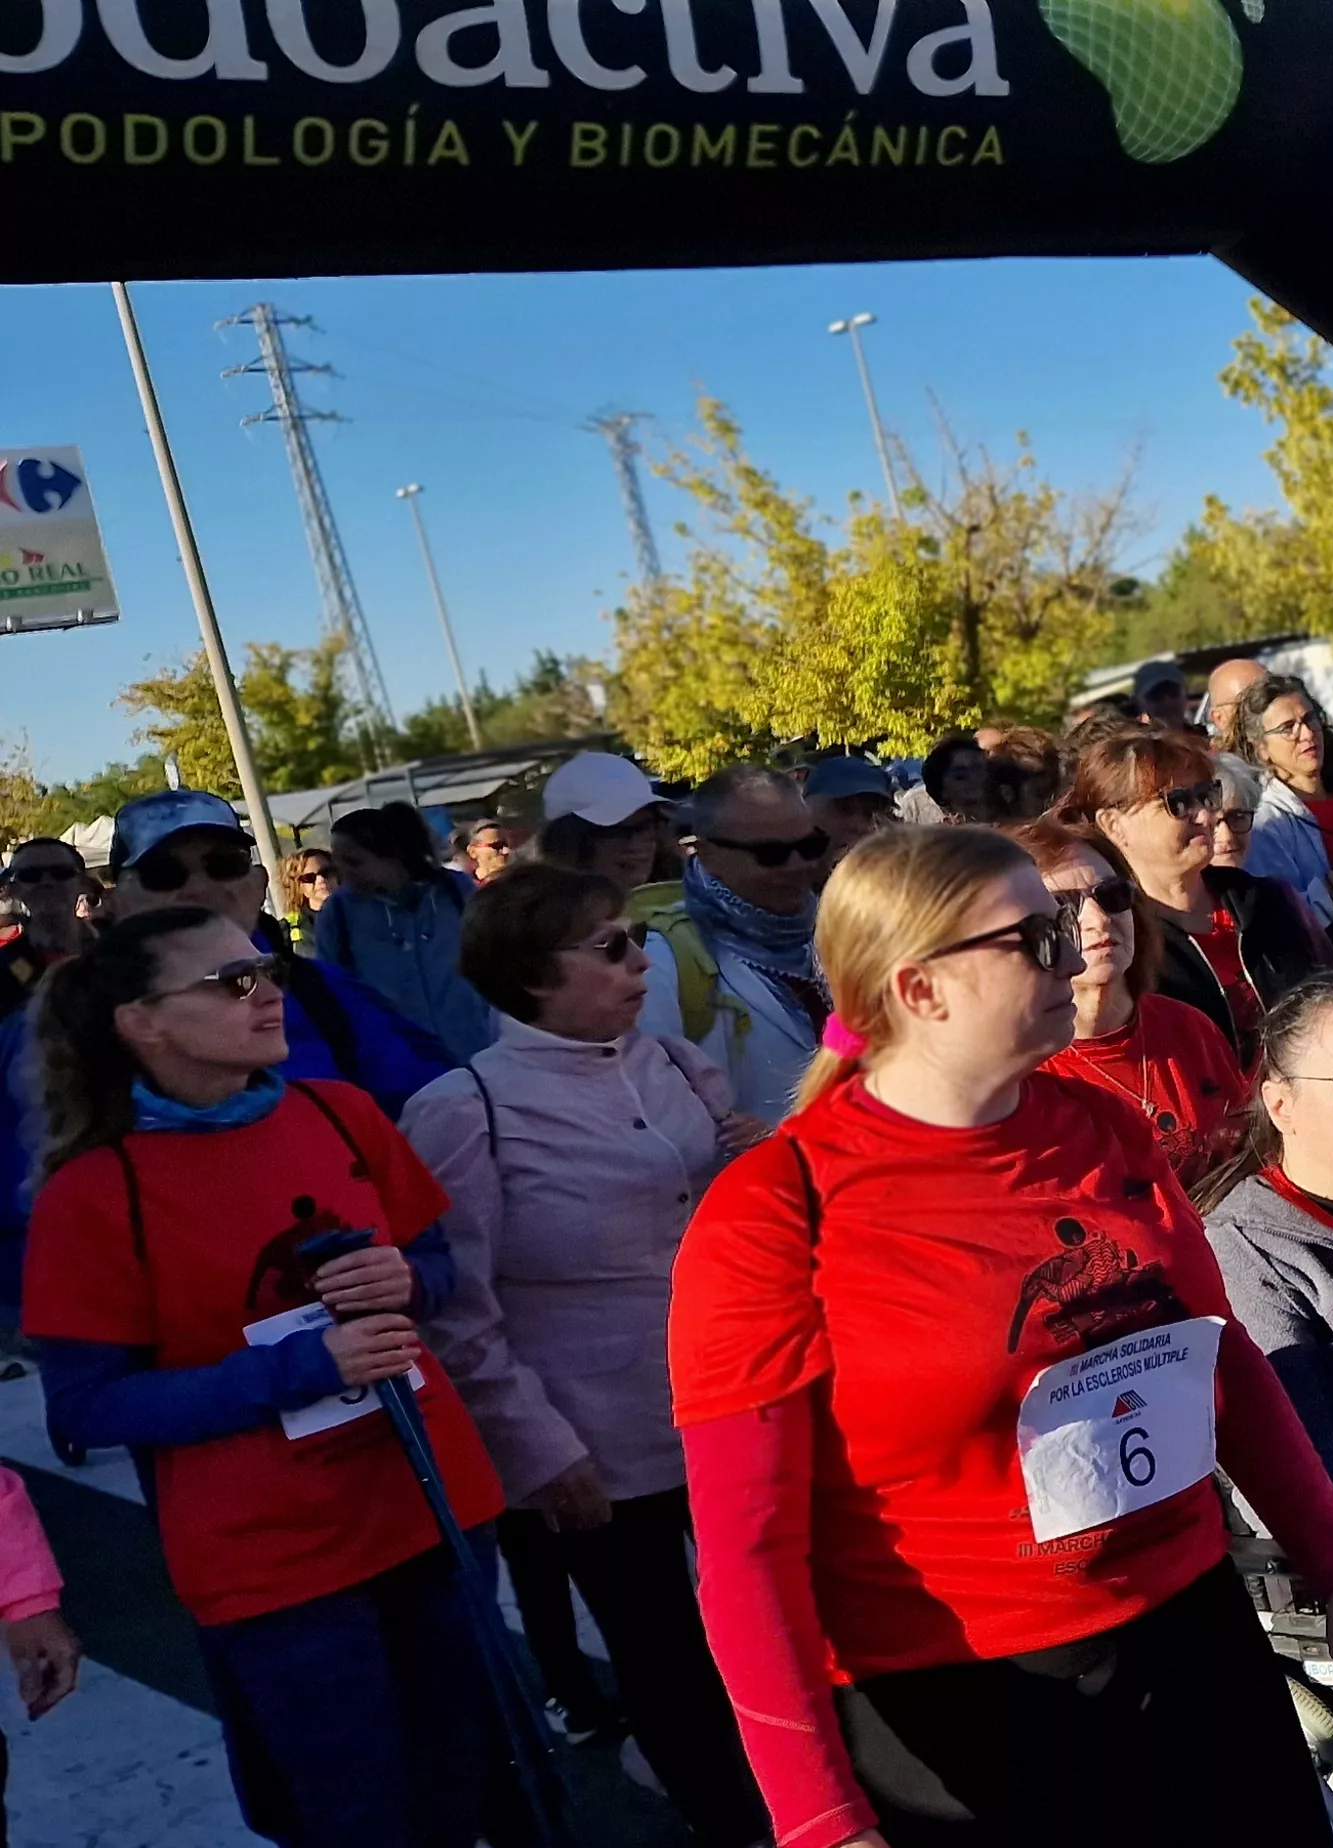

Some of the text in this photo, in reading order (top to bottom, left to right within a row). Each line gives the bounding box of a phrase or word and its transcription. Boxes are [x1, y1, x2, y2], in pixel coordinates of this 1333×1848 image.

[0, 103, 1006, 169] PODOLOGÍA Y BIOMECÁNICA
[1050, 1347, 1189, 1405] POR LA ESCLEROSIS MÚLTIPLE
[1080, 1346, 1118, 1373] MARCHA
[1120, 1332, 1172, 1358] SOLIDARIA
[1119, 1426, 1156, 1488] 6
